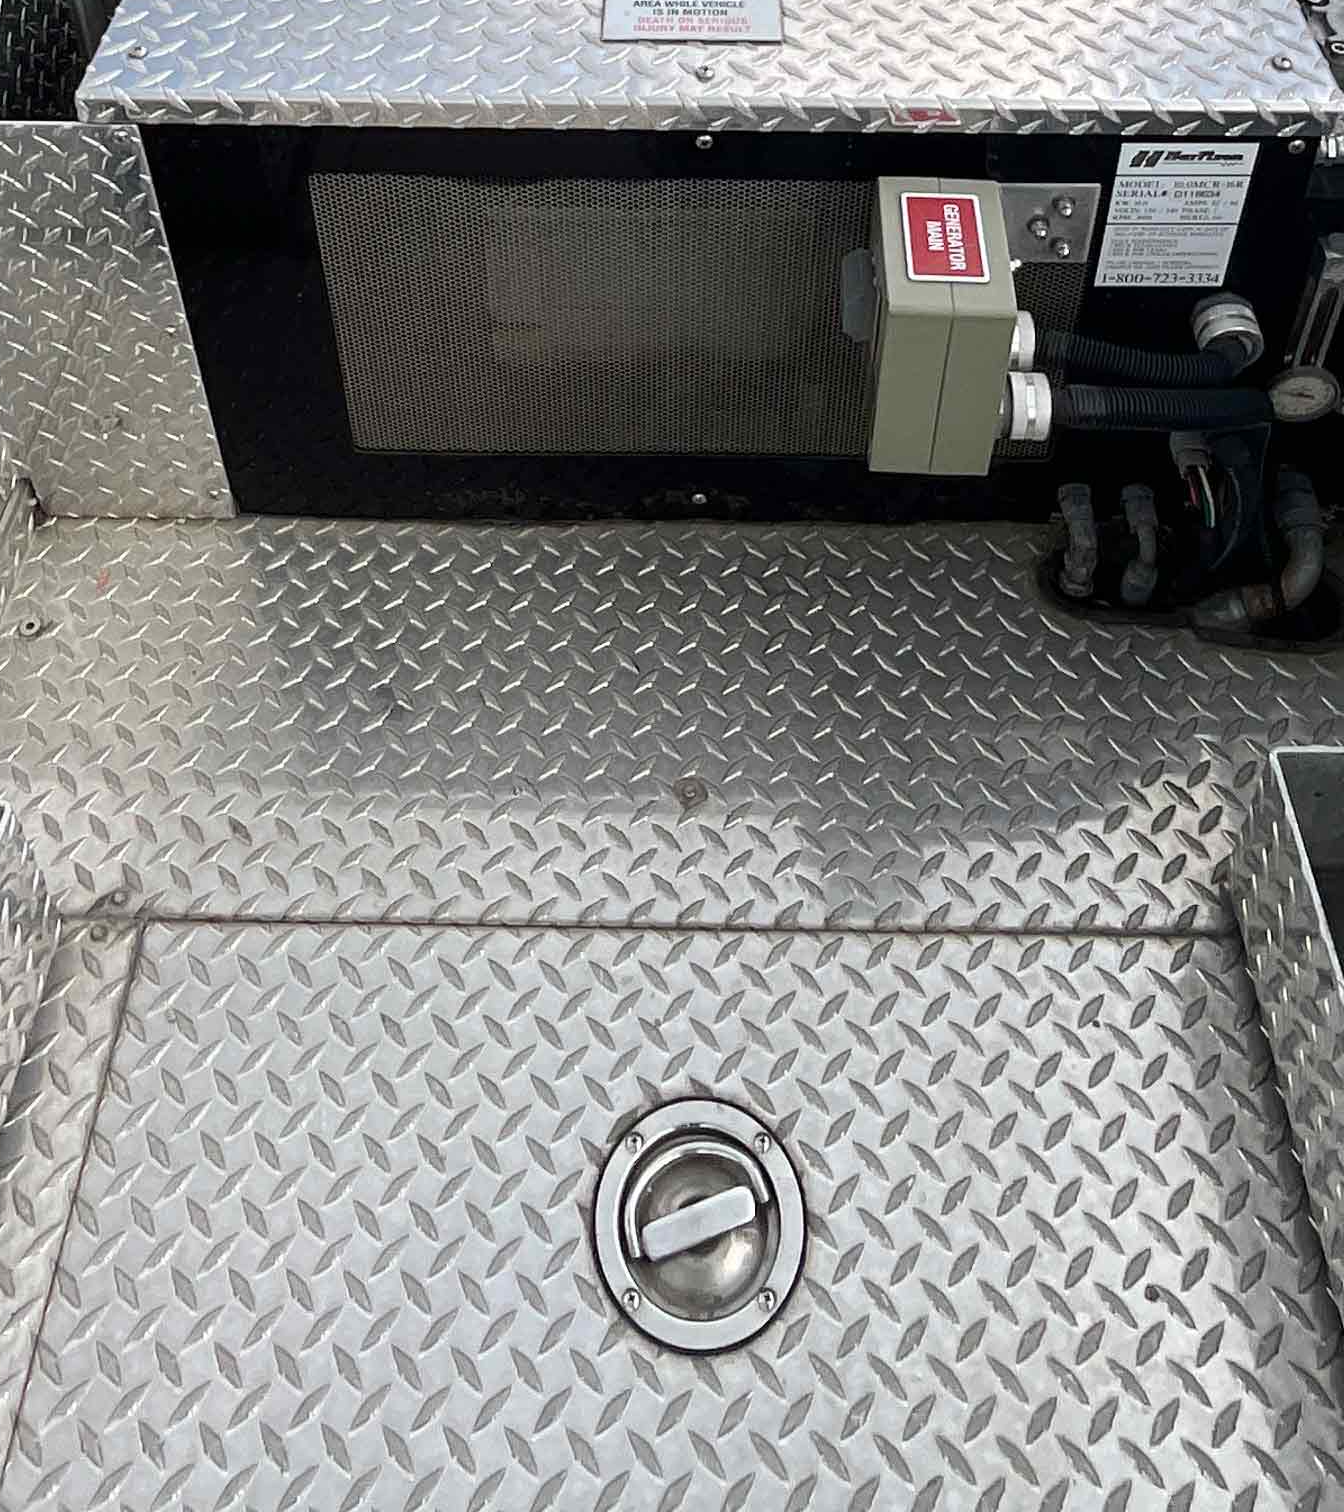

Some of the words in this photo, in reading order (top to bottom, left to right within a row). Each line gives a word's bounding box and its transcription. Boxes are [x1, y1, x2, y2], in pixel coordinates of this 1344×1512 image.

[653, 8, 665, 16] IS
[667, 8, 679, 16] IN
[682, 8, 728, 16] MOTION
[926, 220, 945, 251] MAIN
[943, 203, 967, 270] GENERATOR
[1101, 272, 1220, 284] 1-800-723-3334
